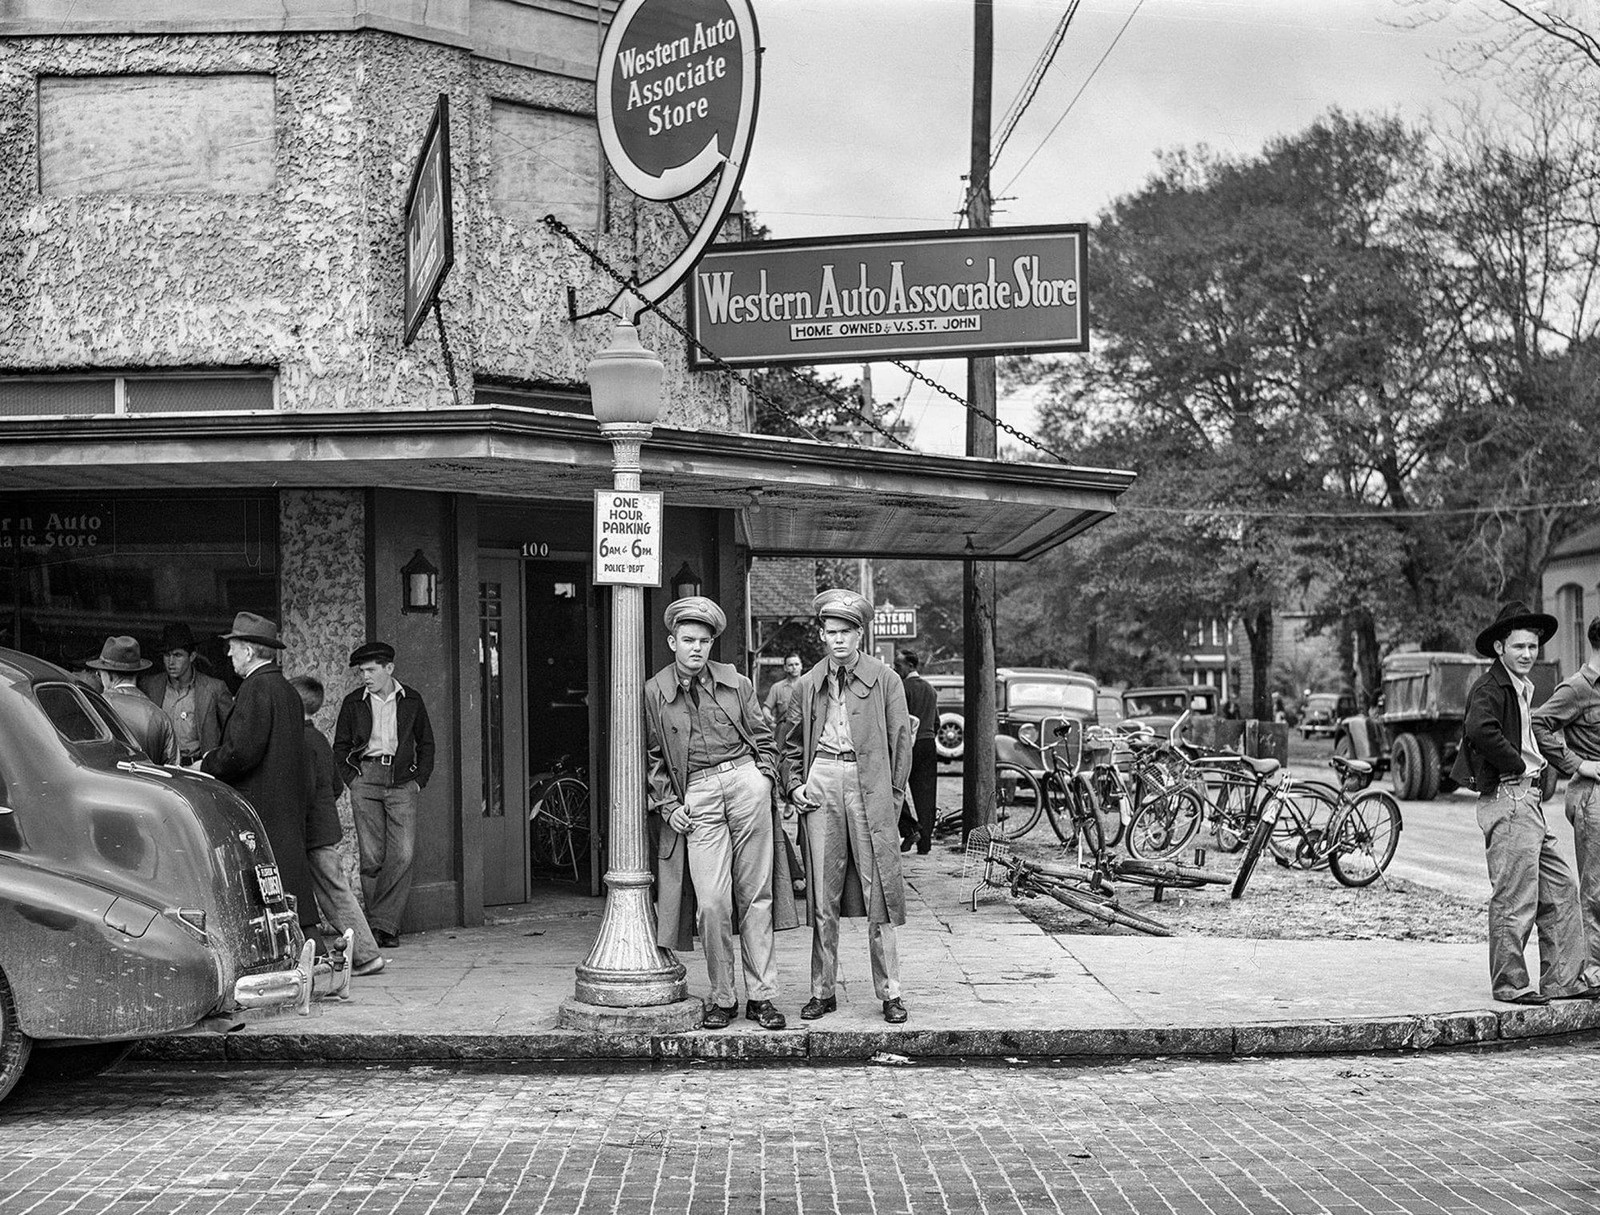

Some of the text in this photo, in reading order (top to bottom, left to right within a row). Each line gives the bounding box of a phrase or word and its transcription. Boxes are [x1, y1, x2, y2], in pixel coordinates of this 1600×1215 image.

[618, 18, 736, 79] Western Auto
[627, 55, 726, 111] Associate
[648, 97, 708, 136] Store
[699, 254, 1077, 325] Western Auto Associate Store
[795, 324, 833, 338] HOME
[839, 322, 883, 336] OWNED
[942, 316, 977, 331] JOHN
[612, 496, 639, 509] ONE
[44, 512, 102, 531] Auto
[609, 509, 643, 521] HOUR
[602, 521, 652, 535] PARKING
[45, 531, 98, 548] Store
[521, 542, 549, 558] 100
[604, 563, 626, 573] POLICE
